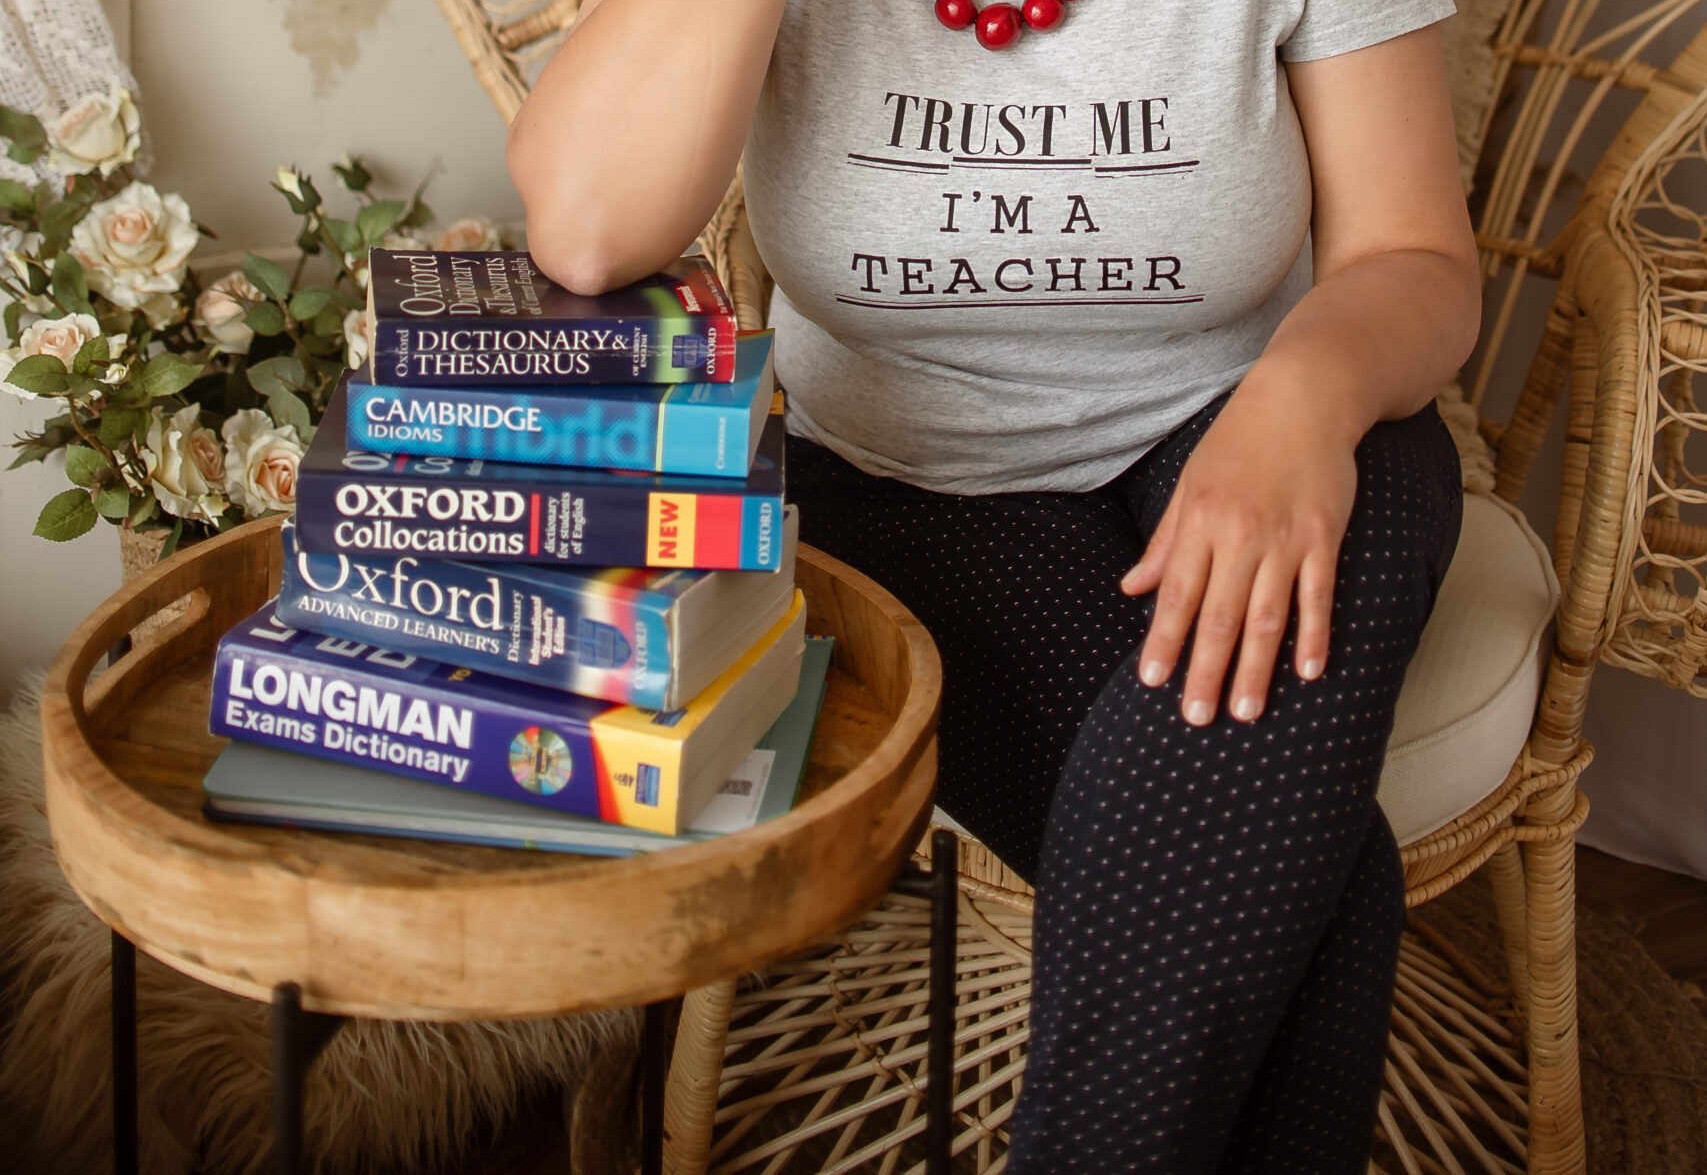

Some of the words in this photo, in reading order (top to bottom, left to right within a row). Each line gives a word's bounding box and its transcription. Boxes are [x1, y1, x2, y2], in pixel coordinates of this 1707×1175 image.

[884, 91, 1067, 157] TRUST
[1089, 97, 1171, 156] ME
[1060, 194, 1100, 233] A
[392, 254, 445, 315] Oxford
[448, 256, 481, 315] Dictionary
[851, 252, 1186, 295] TEACHER
[396, 329, 409, 377] Oxford
[414, 352, 590, 375] THESAURUS
[640, 334, 648, 368] ENGLISH
[706, 327, 717, 375] OXFORD
[365, 397, 542, 432] CAMBRIDGE
[367, 424, 443, 443] IDIOMS
[335, 484, 525, 522] OXFORD
[544, 496, 560, 553] dictionary
[558, 492, 570, 539] students
[572, 498, 586, 539] English
[334, 520, 524, 555] Collocations
[557, 541, 569, 559] for
[570, 540, 582, 554] of
[659, 500, 679, 559] NEW
[758, 502, 773, 566] OXFORD
[298, 552, 504, 631] Oxford
[298, 595, 398, 629] ADVANCED
[507, 589, 524, 663] Dictionary
[633, 621, 647, 690] OXFORD
[229, 658, 474, 750] LONGMAN
[225, 700, 317, 744] Exams
[324, 723, 469, 783] Dictionary
